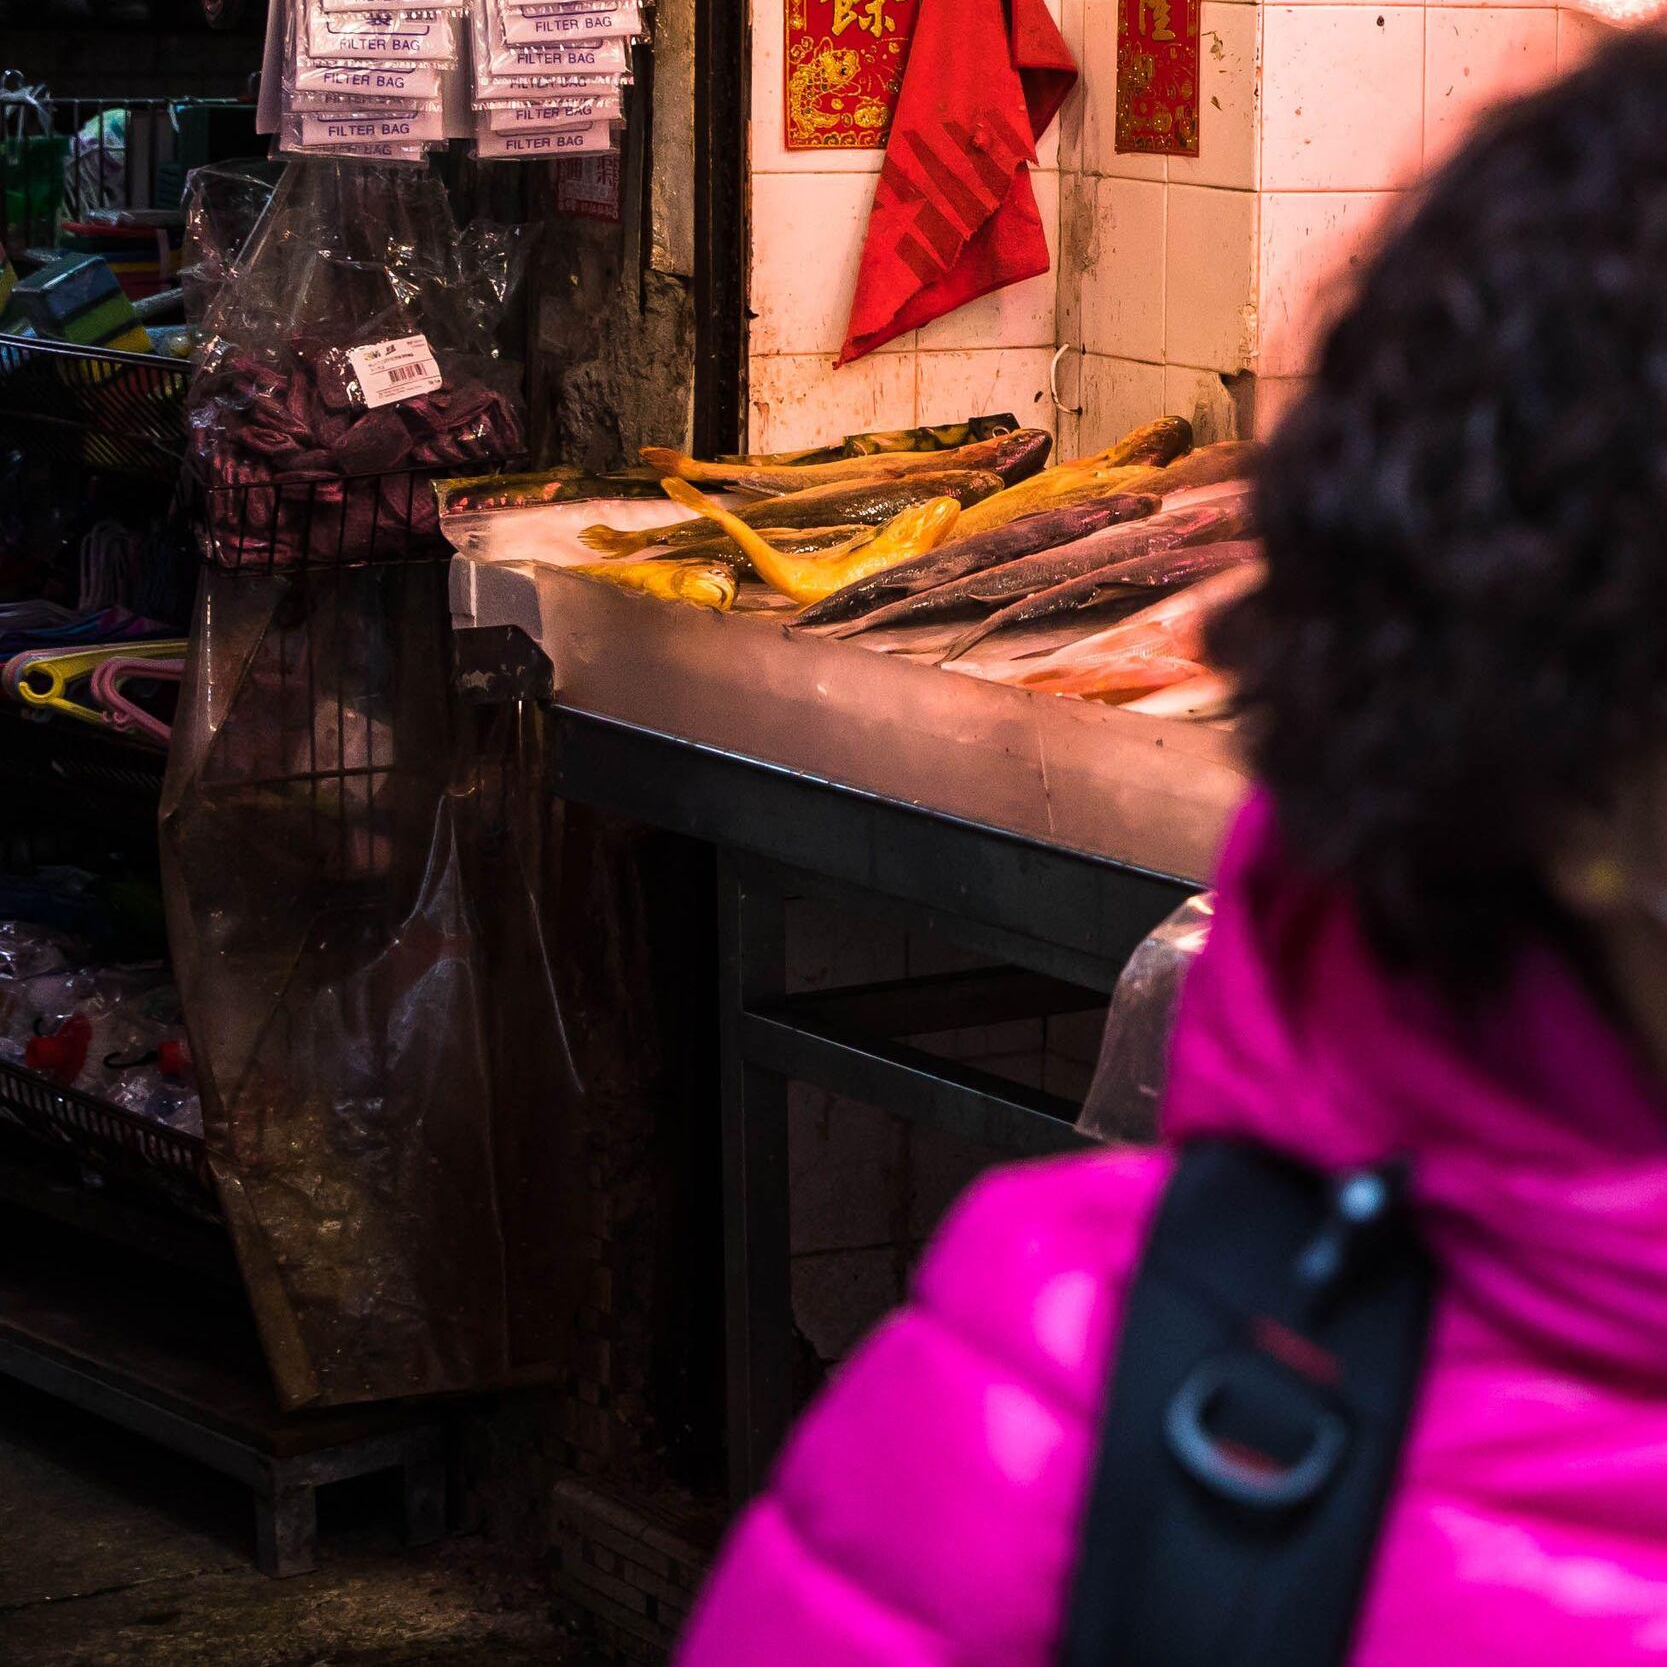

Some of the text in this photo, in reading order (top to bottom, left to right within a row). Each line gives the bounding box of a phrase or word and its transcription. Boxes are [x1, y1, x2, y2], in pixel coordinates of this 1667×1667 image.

[535, 16, 613, 32] FILTER BAG
[339, 38, 421, 51] FILTER BAG
[517, 52, 596, 64] FILTER BAG
[323, 72, 405, 89] FILTER BAG
[515, 107, 560, 120] FILTER
[328, 123, 410, 137] FILTER BAG
[505, 135, 584, 150] FILTER BAG
